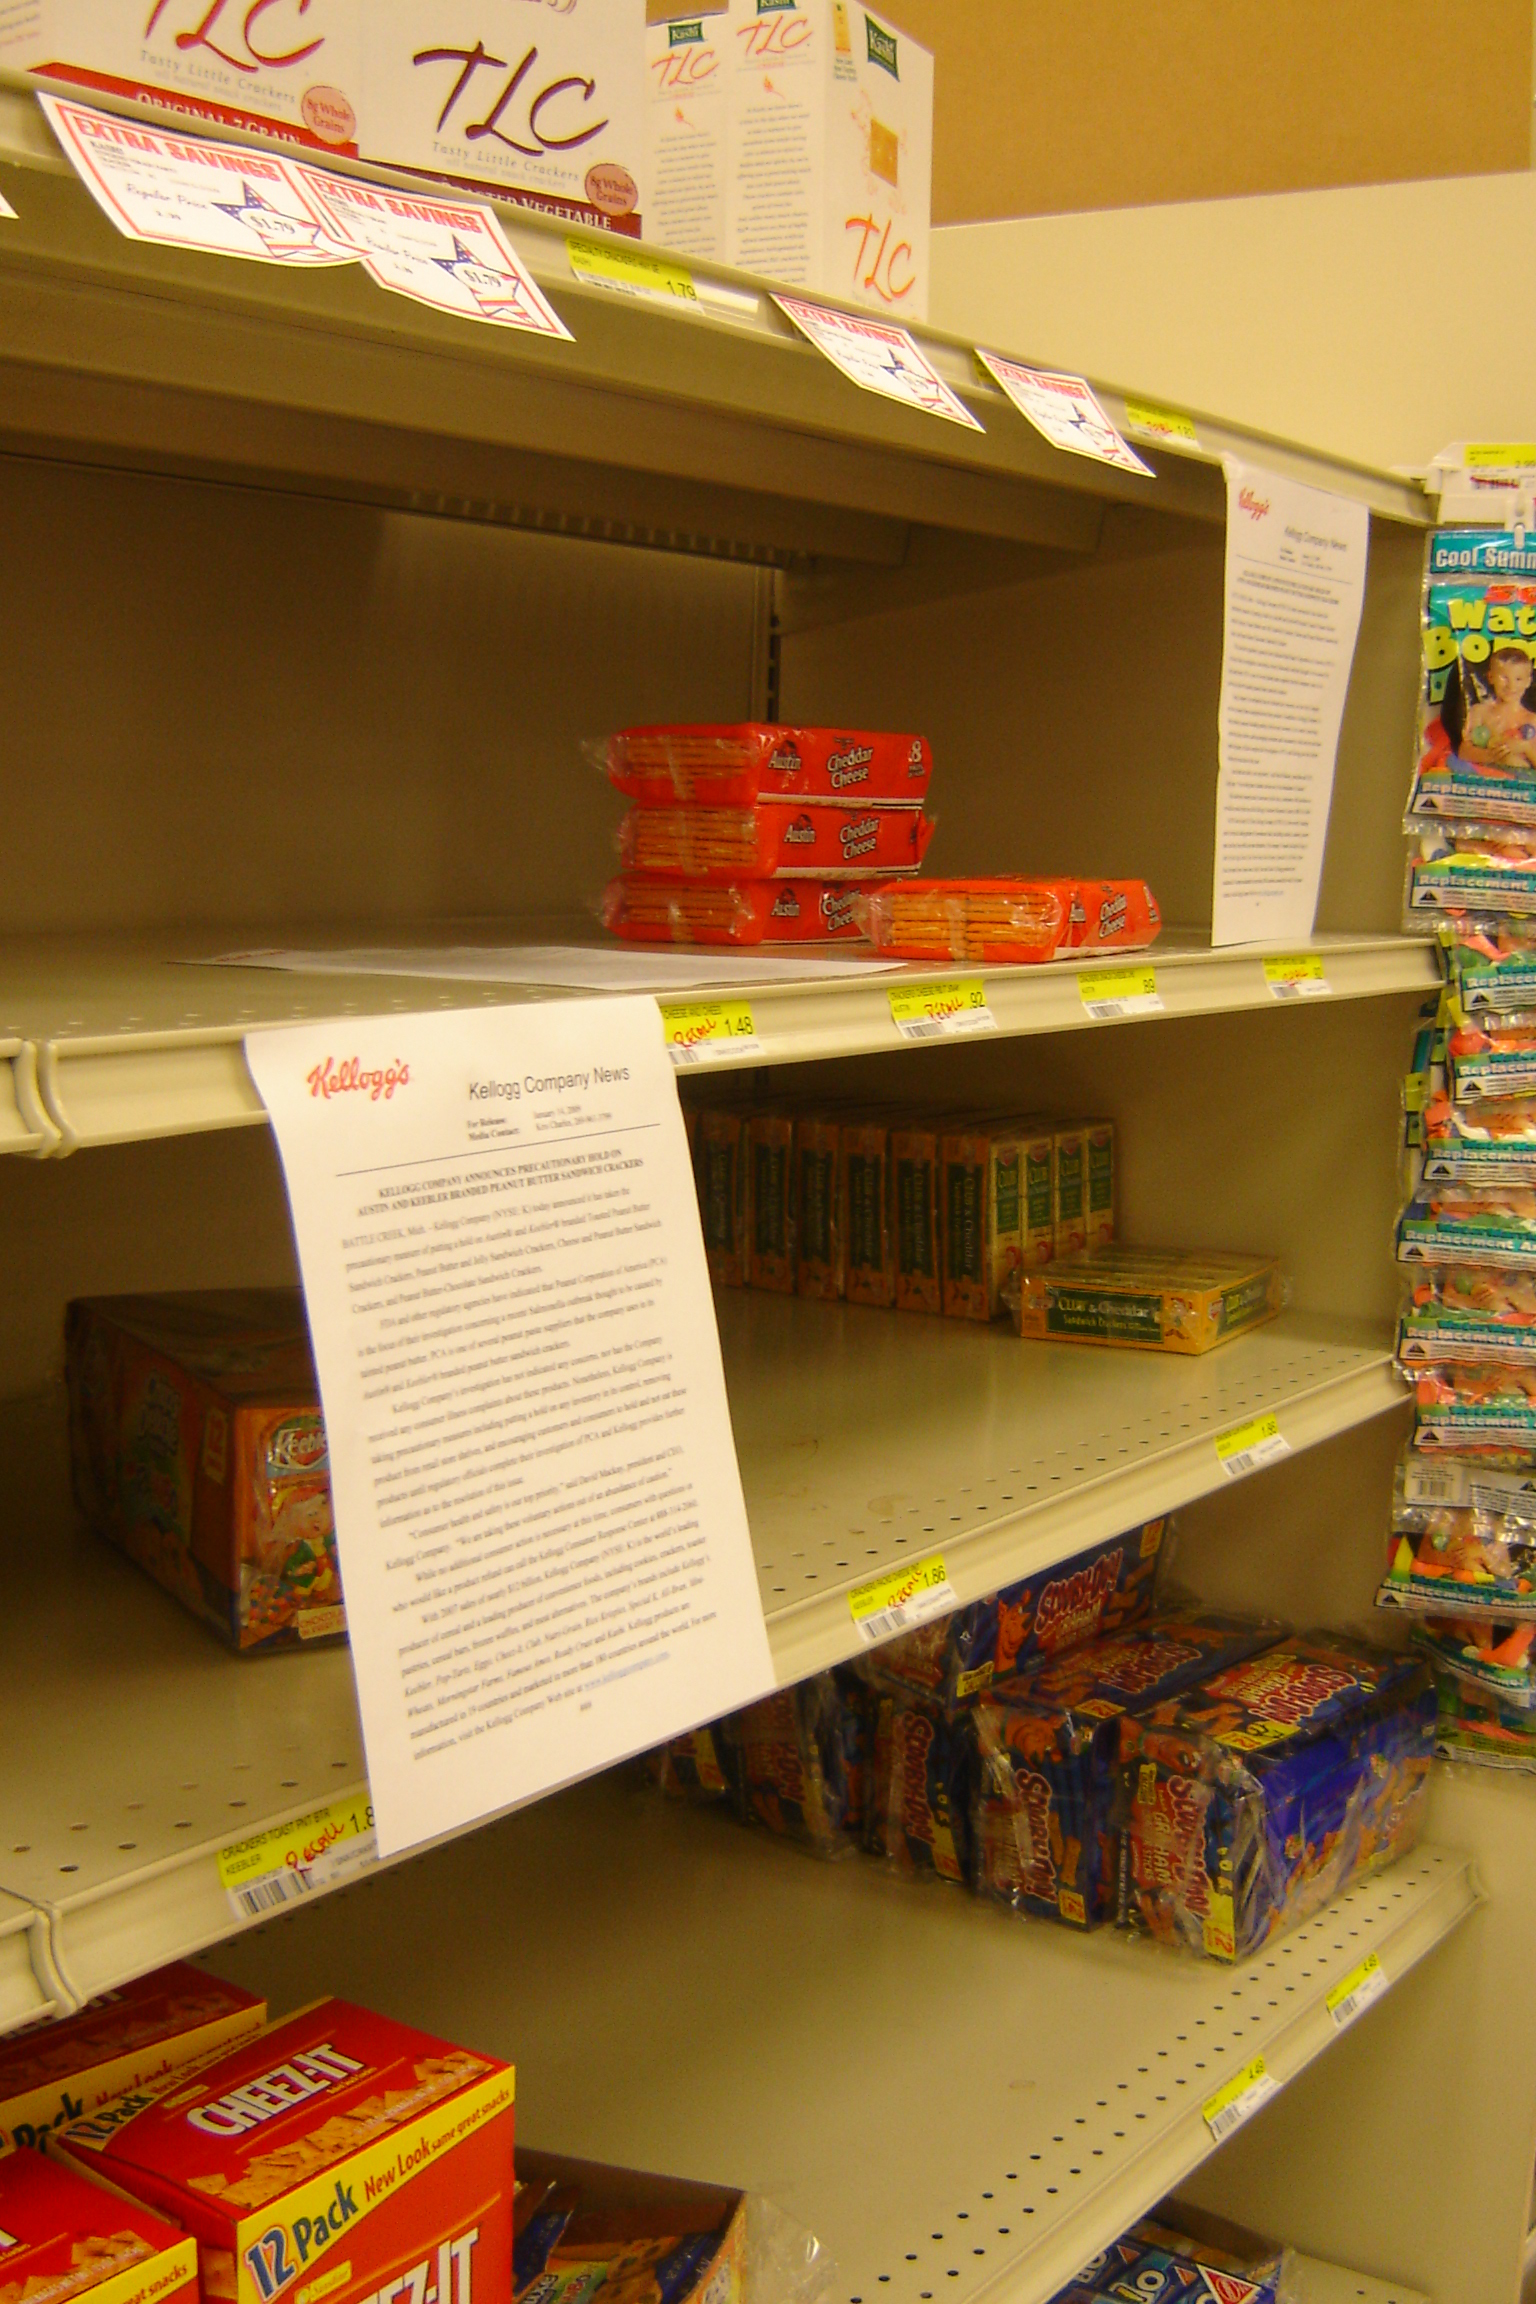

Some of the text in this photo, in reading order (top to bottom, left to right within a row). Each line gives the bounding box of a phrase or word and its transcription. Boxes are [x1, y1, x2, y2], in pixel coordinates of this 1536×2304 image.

[140, 50, 182, 73] Tasty
[188, 63, 232, 85] Little
[238, 76, 297, 104] Crackers
[413, 41, 610, 157] TLC
[73, 115, 163, 156] EXTRA
[165, 141, 281, 182] SAVINGS
[433, 141, 471, 161] Tasty
[478, 148, 518, 168] Little
[524, 160, 580, 182] Crackers
[311, 175, 484, 235] EXTRA SAVINGS
[522, 196, 612, 230] VEGETABLE
[249, 214, 296, 235] $1.79
[845, 213, 916, 303] TLC
[666, 279, 698, 301] 1.79
[1435, 546, 1480, 569] Cool
[827, 745, 874, 773] Cheddar
[830, 766, 869, 790] Cheese
[1421, 781, 1531, 802] Replacement
[839, 816, 880, 844] Cheddar
[843, 837, 878, 861] Cheese
[1418, 873, 1531, 894] Replacement
[724, 1015, 754, 1037] 1.48
[307, 1055, 411, 1102] Kellogg's
[469, 1066, 631, 1102] Kellogg Company News
[1403, 1229, 1515, 1251] Replacement
[1406, 1326, 1517, 1346] Replacement
[1420, 1413, 1529, 1428] Replacement
[349, 1805, 375, 1833] 1.8
[187, 2042, 366, 2136] CHEEZ-IT
[104, 2093, 155, 2125] Pack
[245, 2228, 296, 2302] 12
[291, 2180, 360, 2264] Pack
[363, 2164, 397, 2203] New
[396, 2136, 432, 2177] Look
[431, 2126, 457, 2154] same
[456, 2109, 482, 2137] great
[481, 2089, 511, 2119] snacks
